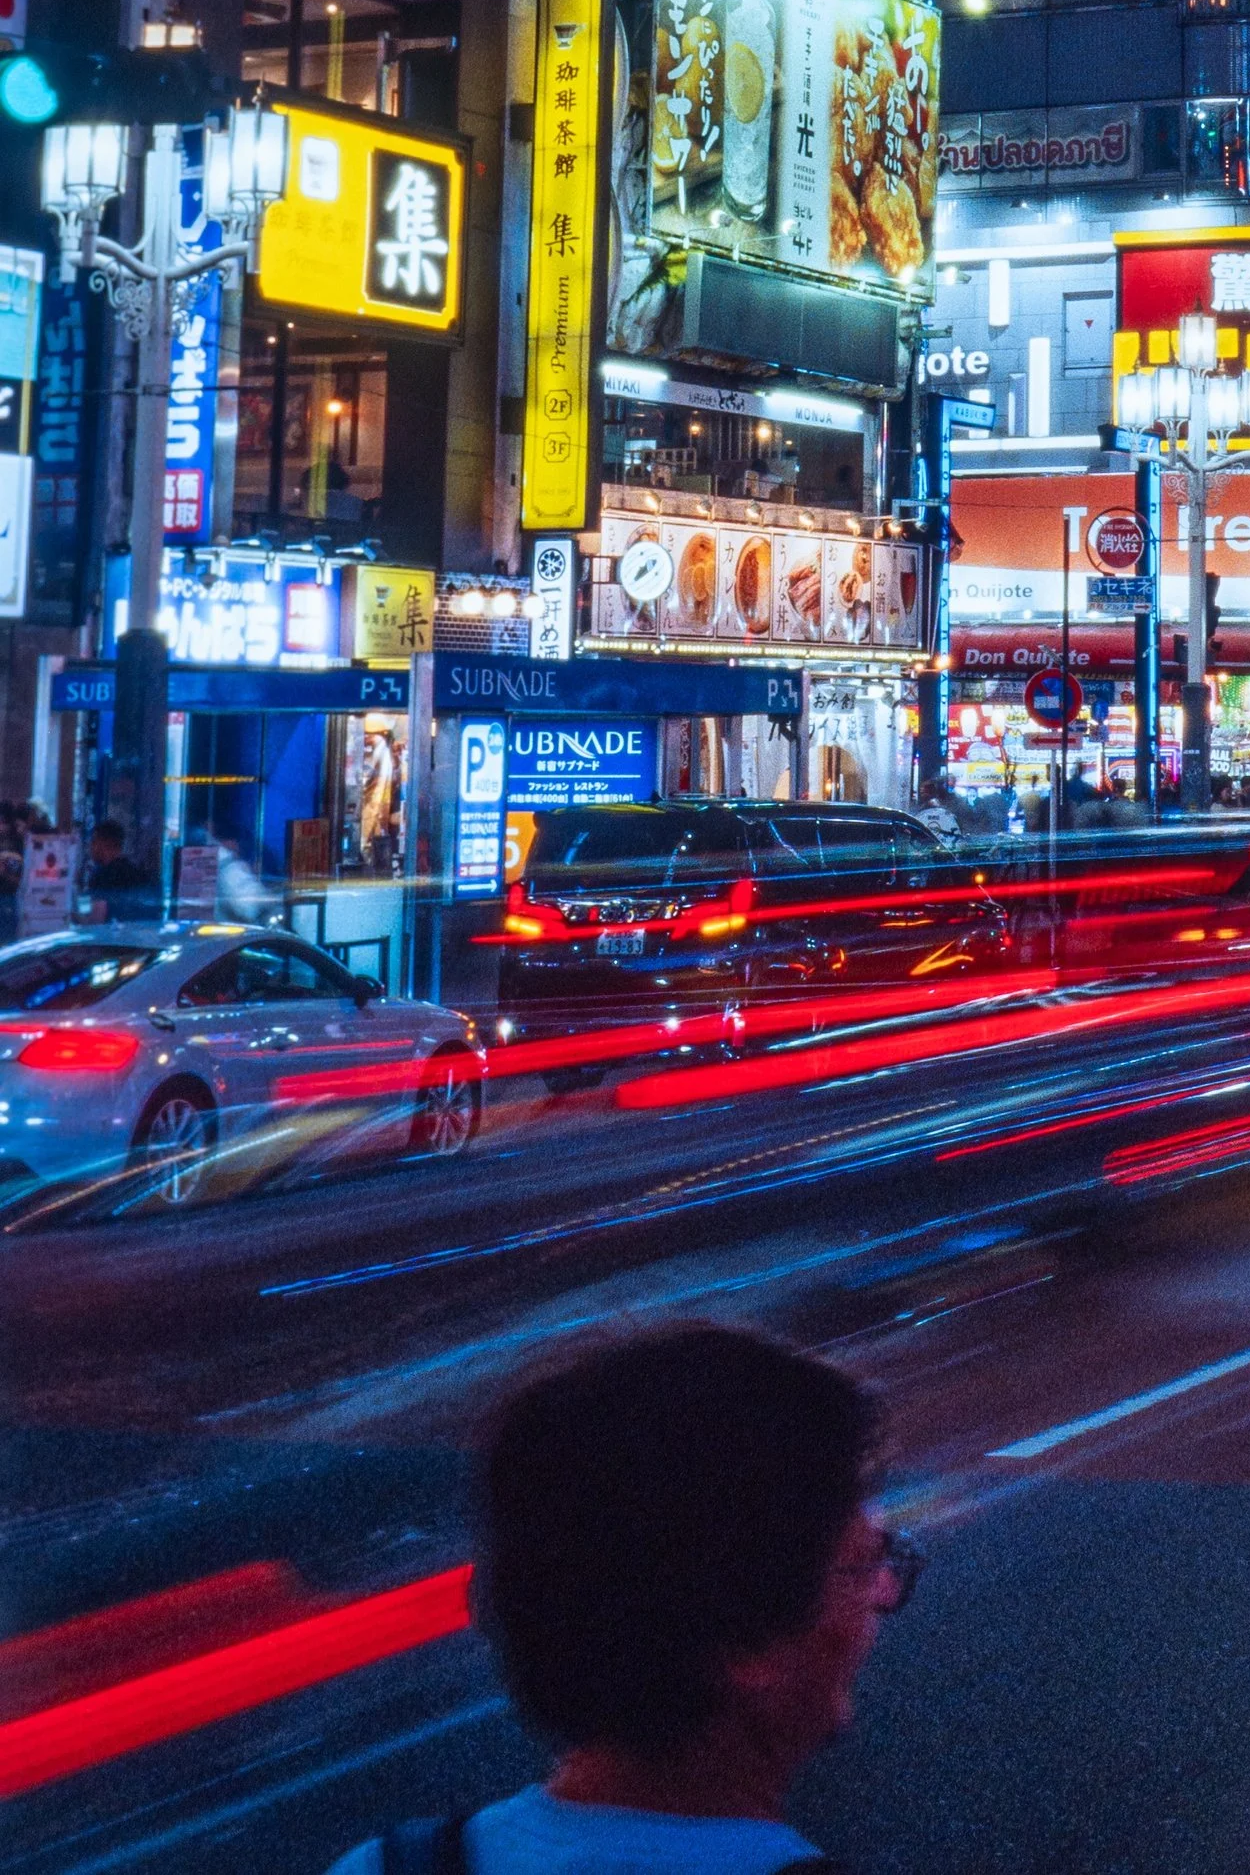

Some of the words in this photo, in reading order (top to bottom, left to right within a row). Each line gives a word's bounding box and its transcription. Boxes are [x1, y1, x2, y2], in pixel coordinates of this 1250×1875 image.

[554, 61, 580, 181] 珈琲茶館
[796, 113, 815, 159] 光
[375, 161, 449, 296] 集
[546, 213, 580, 258] 集
[549, 274, 570, 374] Premium
[549, 397, 568, 416] 2F
[794, 406, 834, 425] MONJA
[547, 439, 568, 458] 3F
[1100, 533, 1139, 553] 消火栓
[966, 583, 1033, 602] Quijote
[398, 583, 429, 648] 集
[965, 648, 1006, 666] Don
[451, 667, 556, 702] SUBNADE
[509, 731, 642, 759] UBNADE
[467, 737, 486, 794] P
[536, 760, 600, 772] 新宿サブナード
[574, 782, 608, 791] レストラン
